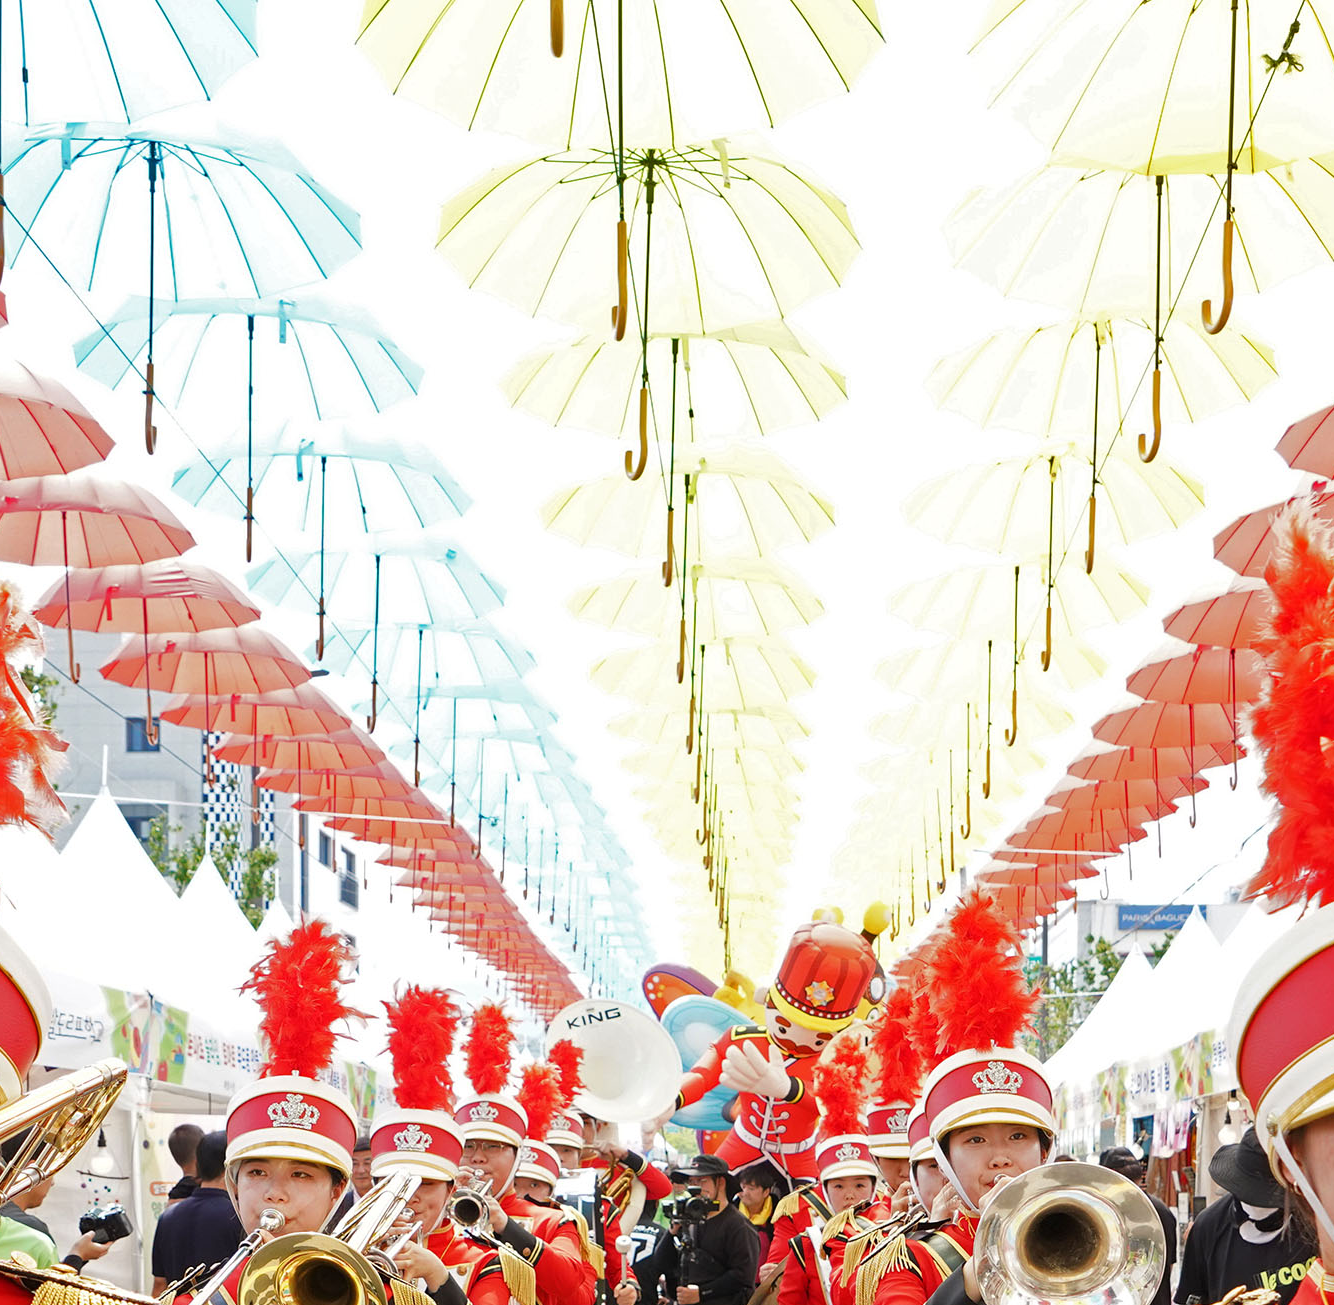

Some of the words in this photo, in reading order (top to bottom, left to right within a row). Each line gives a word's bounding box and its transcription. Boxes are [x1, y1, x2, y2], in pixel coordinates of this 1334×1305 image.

[1122, 913, 1150, 922] PARIS
[1156, 913, 1189, 922] BAGUE
[566, 1007, 621, 1030] KING
